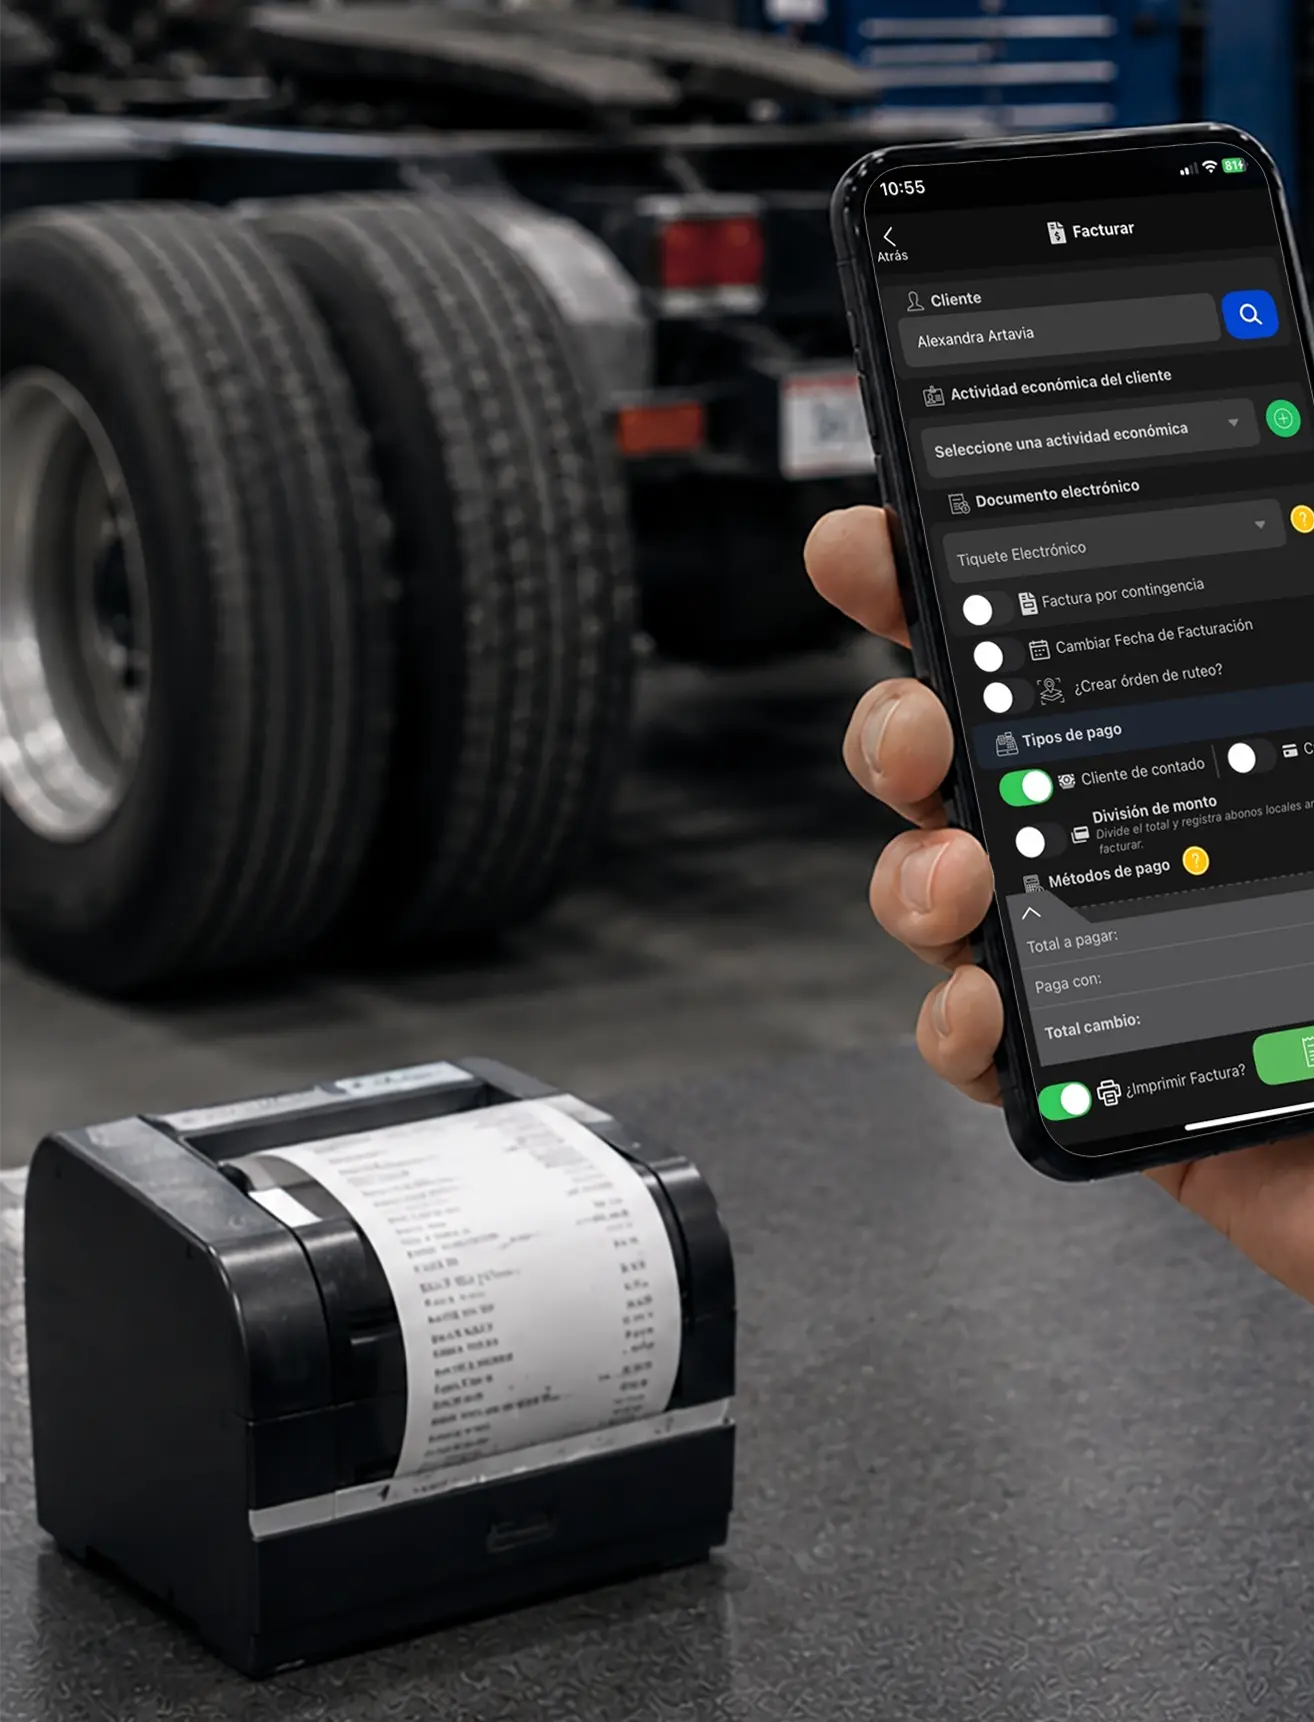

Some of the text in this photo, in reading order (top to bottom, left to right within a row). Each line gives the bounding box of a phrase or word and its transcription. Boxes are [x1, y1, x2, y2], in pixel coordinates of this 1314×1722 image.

[880, 180, 925, 196] 10:55
[1073, 224, 1134, 238] Facturar
[878, 249, 908, 262] Atrás
[931, 293, 981, 307] Cliente
[918, 326, 1034, 348] Alexandra Artavia
[951, 370, 1172, 400] Actividad económica del cliente
[935, 422, 1188, 458] Seleccione una actividad económica
[976, 480, 1140, 507] Documento electrónico
[956, 542, 1086, 567] Tiquete Electrónico
[1042, 578, 1204, 608] Factura por contingencia
[1056, 618, 1253, 654] Cambiar Fecha de Facturación
[1074, 662, 1223, 696] ¿Crear órden de ruteo?
[1022, 725, 1122, 748] Tipos de pago
[1081, 757, 1205, 785] Cliente de contado
[1092, 796, 1217, 824] División de monto
[1096, 825, 1130, 839] Divide
[1133, 823, 1142, 834] el
[1145, 819, 1169, 832] total
[1172, 820, 1179, 831] y
[1182, 814, 1222, 828] registra
[1225, 808, 1263, 821] abonos
[1266, 802, 1302, 815] locales
[1099, 840, 1143, 854] facturar.
[1048, 861, 1170, 888] Métodos de pago
[1026, 931, 1118, 953] Total a pagar:
[1035, 975, 1102, 994] Paga con:
[1044, 1014, 1141, 1039] Total cambio:
[1126, 1063, 1245, 1099] ¿Imprimir Factura?
